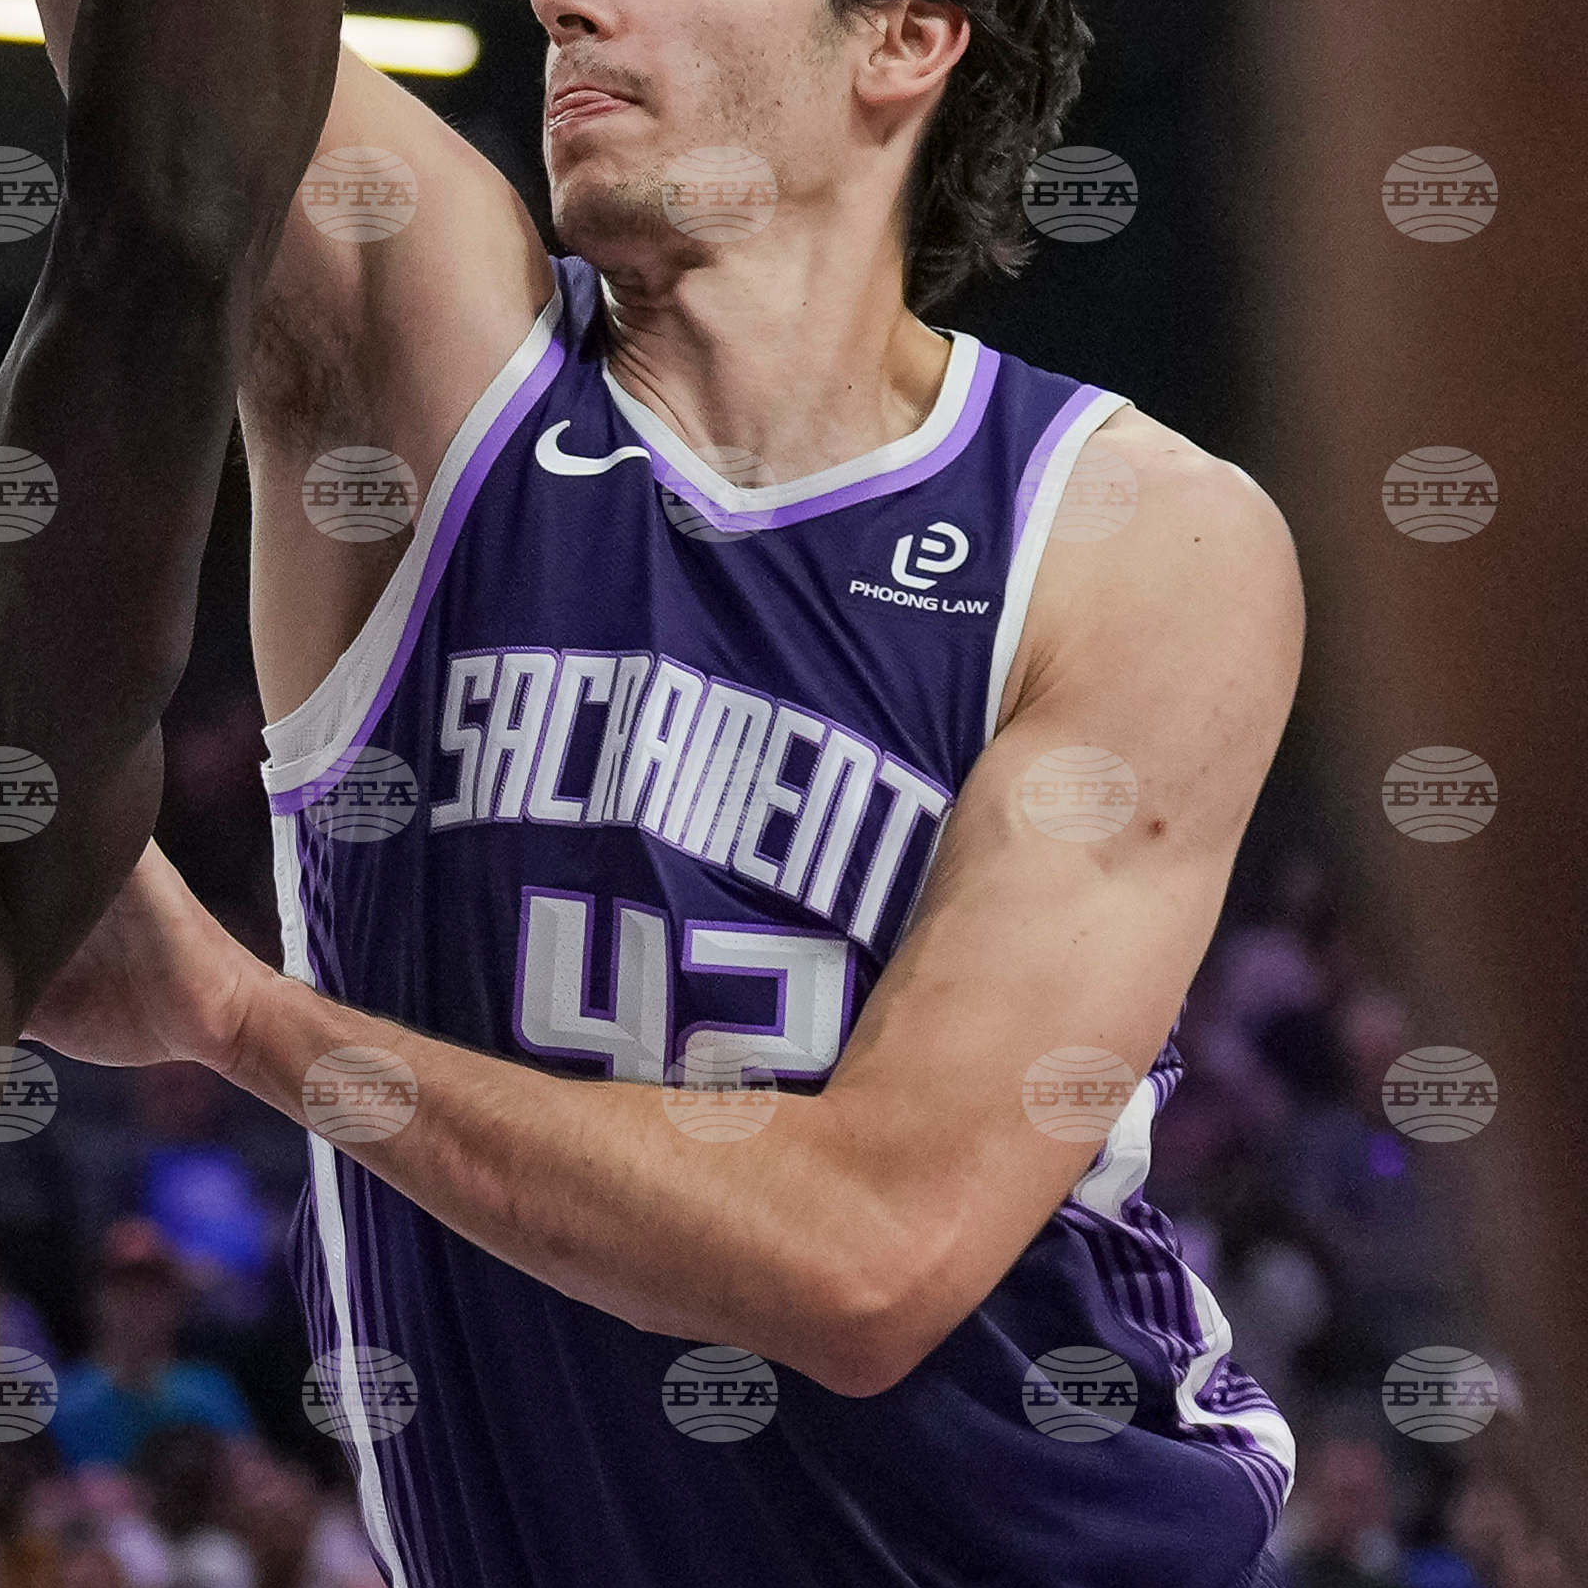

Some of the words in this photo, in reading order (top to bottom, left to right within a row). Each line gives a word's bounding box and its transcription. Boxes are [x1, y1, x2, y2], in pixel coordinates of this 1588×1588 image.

[849, 579, 939, 612] PHOONG
[941, 598, 990, 615] LAW
[429, 645, 955, 947] SACRAMENT
[513, 884, 857, 1083] 42
